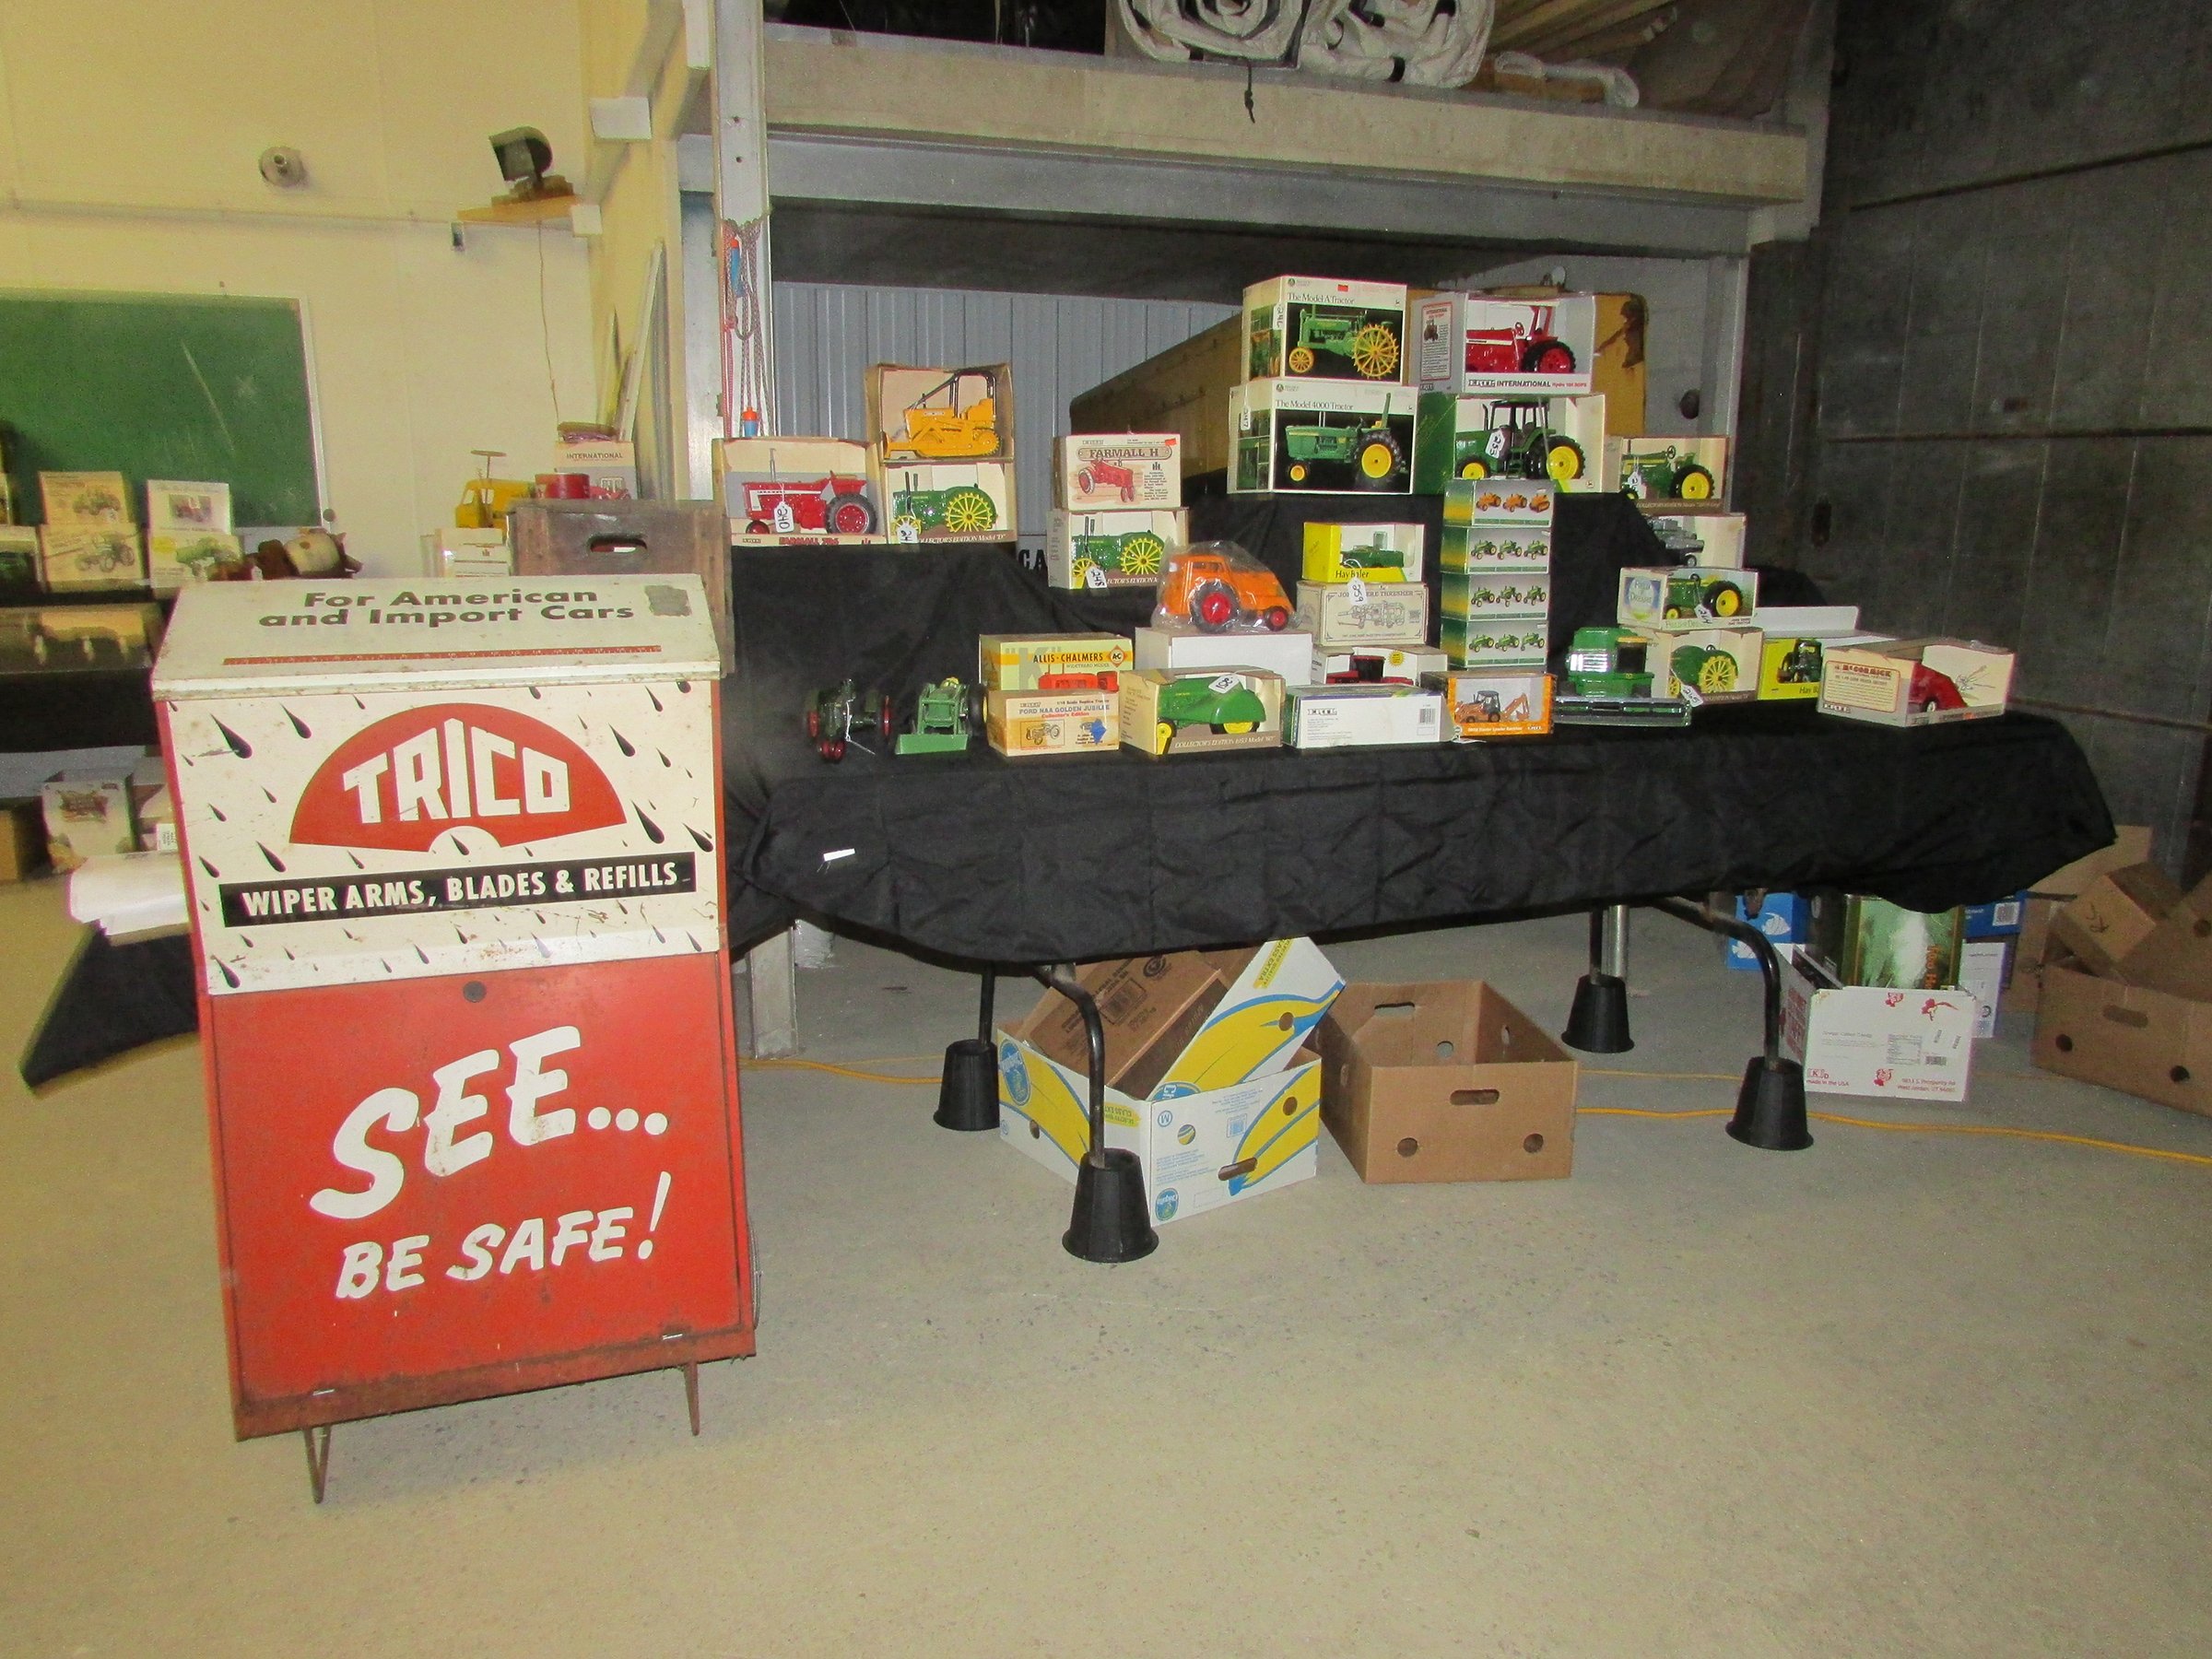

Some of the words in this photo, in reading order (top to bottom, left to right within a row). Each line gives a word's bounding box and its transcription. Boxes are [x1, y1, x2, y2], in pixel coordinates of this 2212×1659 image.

[1288, 292, 1301, 301] The
[1302, 293, 1323, 303] Model
[1331, 296, 1355, 305] Tractor
[1496, 380, 1551, 388] INTERNATIONAL
[1276, 399, 1289, 408] The
[1290, 400, 1311, 409] Model
[1312, 401, 1330, 409] 4000
[1330, 401, 1354, 410] Tractor
[1089, 448, 1146, 459] FARMALL
[1149, 448, 1159, 457] H
[777, 508, 791, 530] 240
[1335, 570, 1349, 579] Hay
[304, 592, 374, 608] For
[389, 587, 598, 606] American
[259, 609, 348, 628] and
[369, 606, 524, 629] Import
[540, 604, 635, 621] Cars
[1033, 653, 1055, 664] ALLIS
[1061, 653, 1104, 663] CHALMERS
[341, 717, 571, 825] TRICO
[241, 887, 336, 917] WIPER
[345, 878, 438, 910] ARMS,
[445, 870, 547, 902] BLADES
[555, 866, 574, 892] &
[584, 862, 678, 892] REFILLS
[309, 1026, 668, 1218] SEE...
[335, 1234, 430, 1299] BE
[446, 1171, 672, 1280] SAFE!
